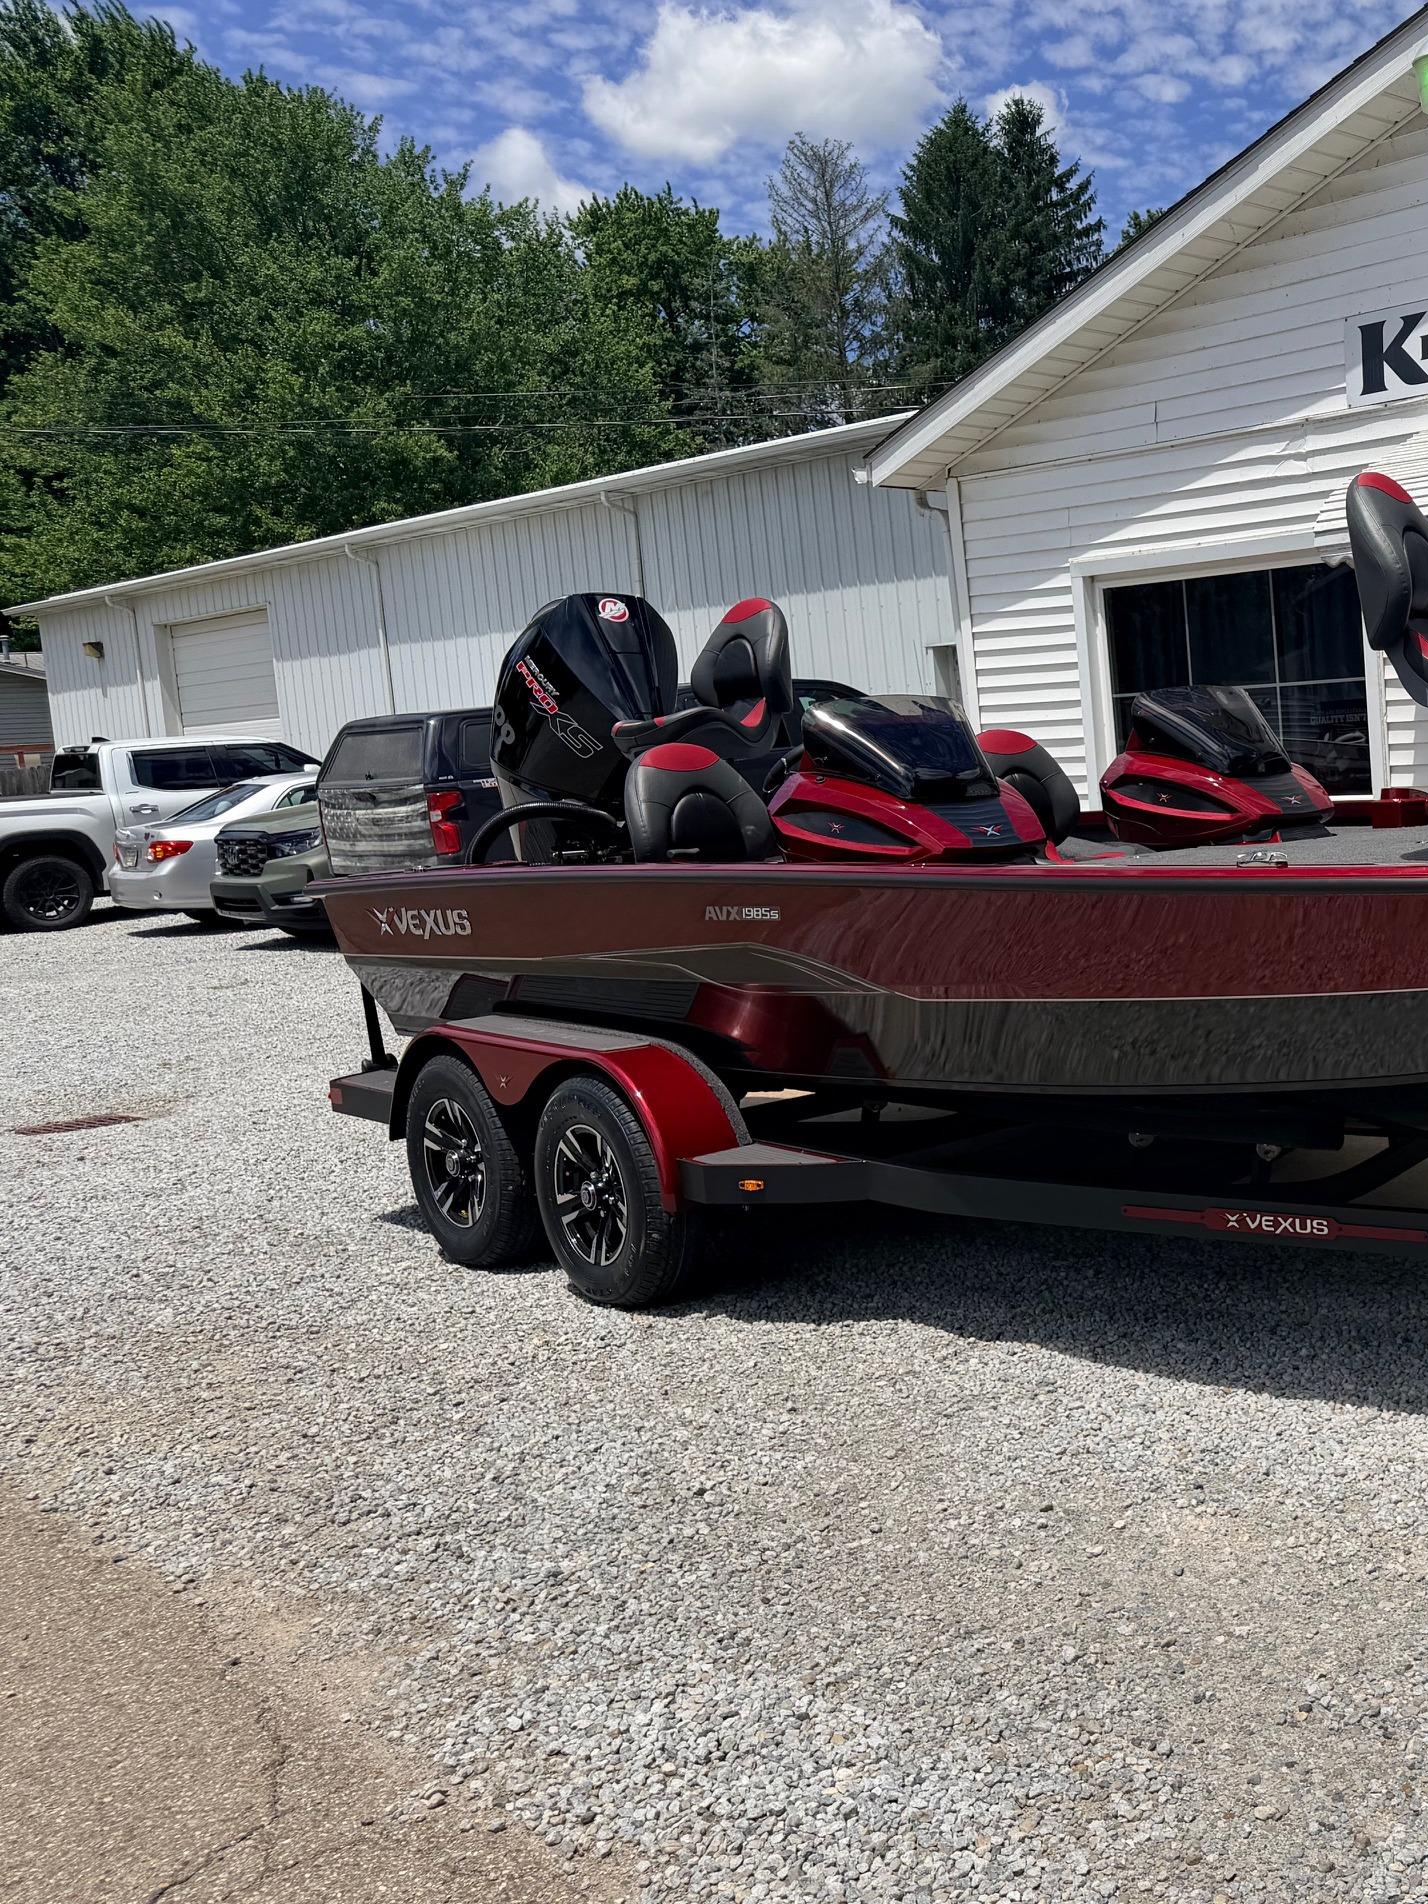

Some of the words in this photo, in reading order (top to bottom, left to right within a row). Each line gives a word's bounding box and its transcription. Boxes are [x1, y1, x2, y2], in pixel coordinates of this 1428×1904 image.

[515, 661, 559, 715] PRO
[524, 655, 560, 696] MERCURY
[529, 701, 604, 759] XS
[390, 906, 472, 940] VEXUS
[704, 905, 740, 921] AVX
[742, 907, 779, 919] 1985s
[1243, 1212, 1329, 1235] VEXUS
